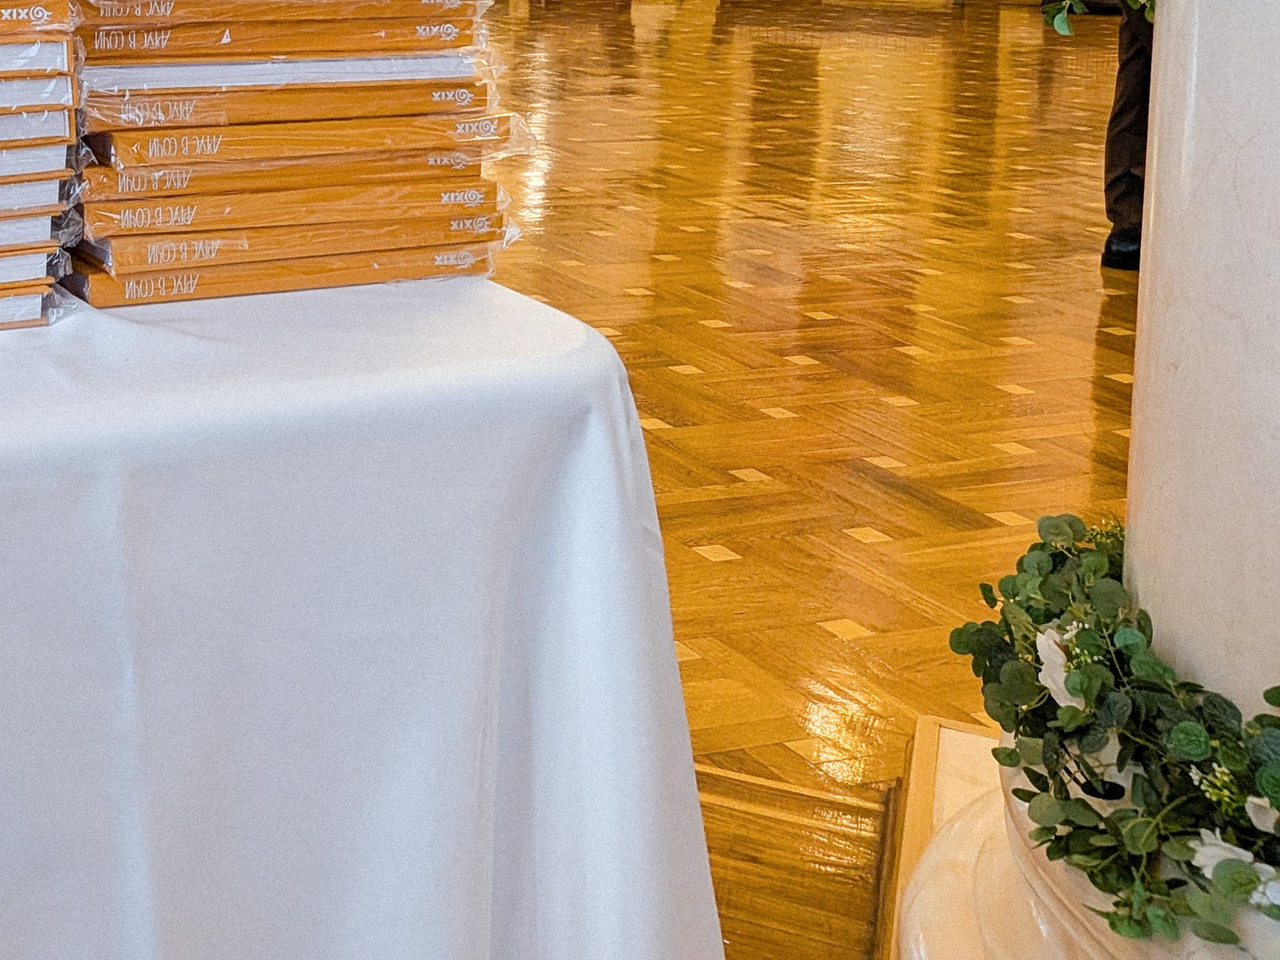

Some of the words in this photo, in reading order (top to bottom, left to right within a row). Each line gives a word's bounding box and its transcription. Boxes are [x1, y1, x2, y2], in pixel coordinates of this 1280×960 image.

[0, 8, 29, 20] XIX
[128, 30, 136, 49] В
[141, 30, 171, 49] АРГУС
[416, 25, 440, 37] XIX
[432, 90, 455, 101] XIX
[456, 122, 479, 134] XIX
[149, 137, 177, 157] СОЧИ
[181, 136, 189, 155] В
[193, 135, 223, 154] АРГУС
[427, 156, 450, 165] XIX
[440, 192, 464, 203] XIX
[155, 207, 162, 226] В
[166, 205, 197, 225] АРГУС
[450, 220, 472, 231] XIX
[158, 277, 165, 296] В
[173, 274, 199, 294] АРГУС
